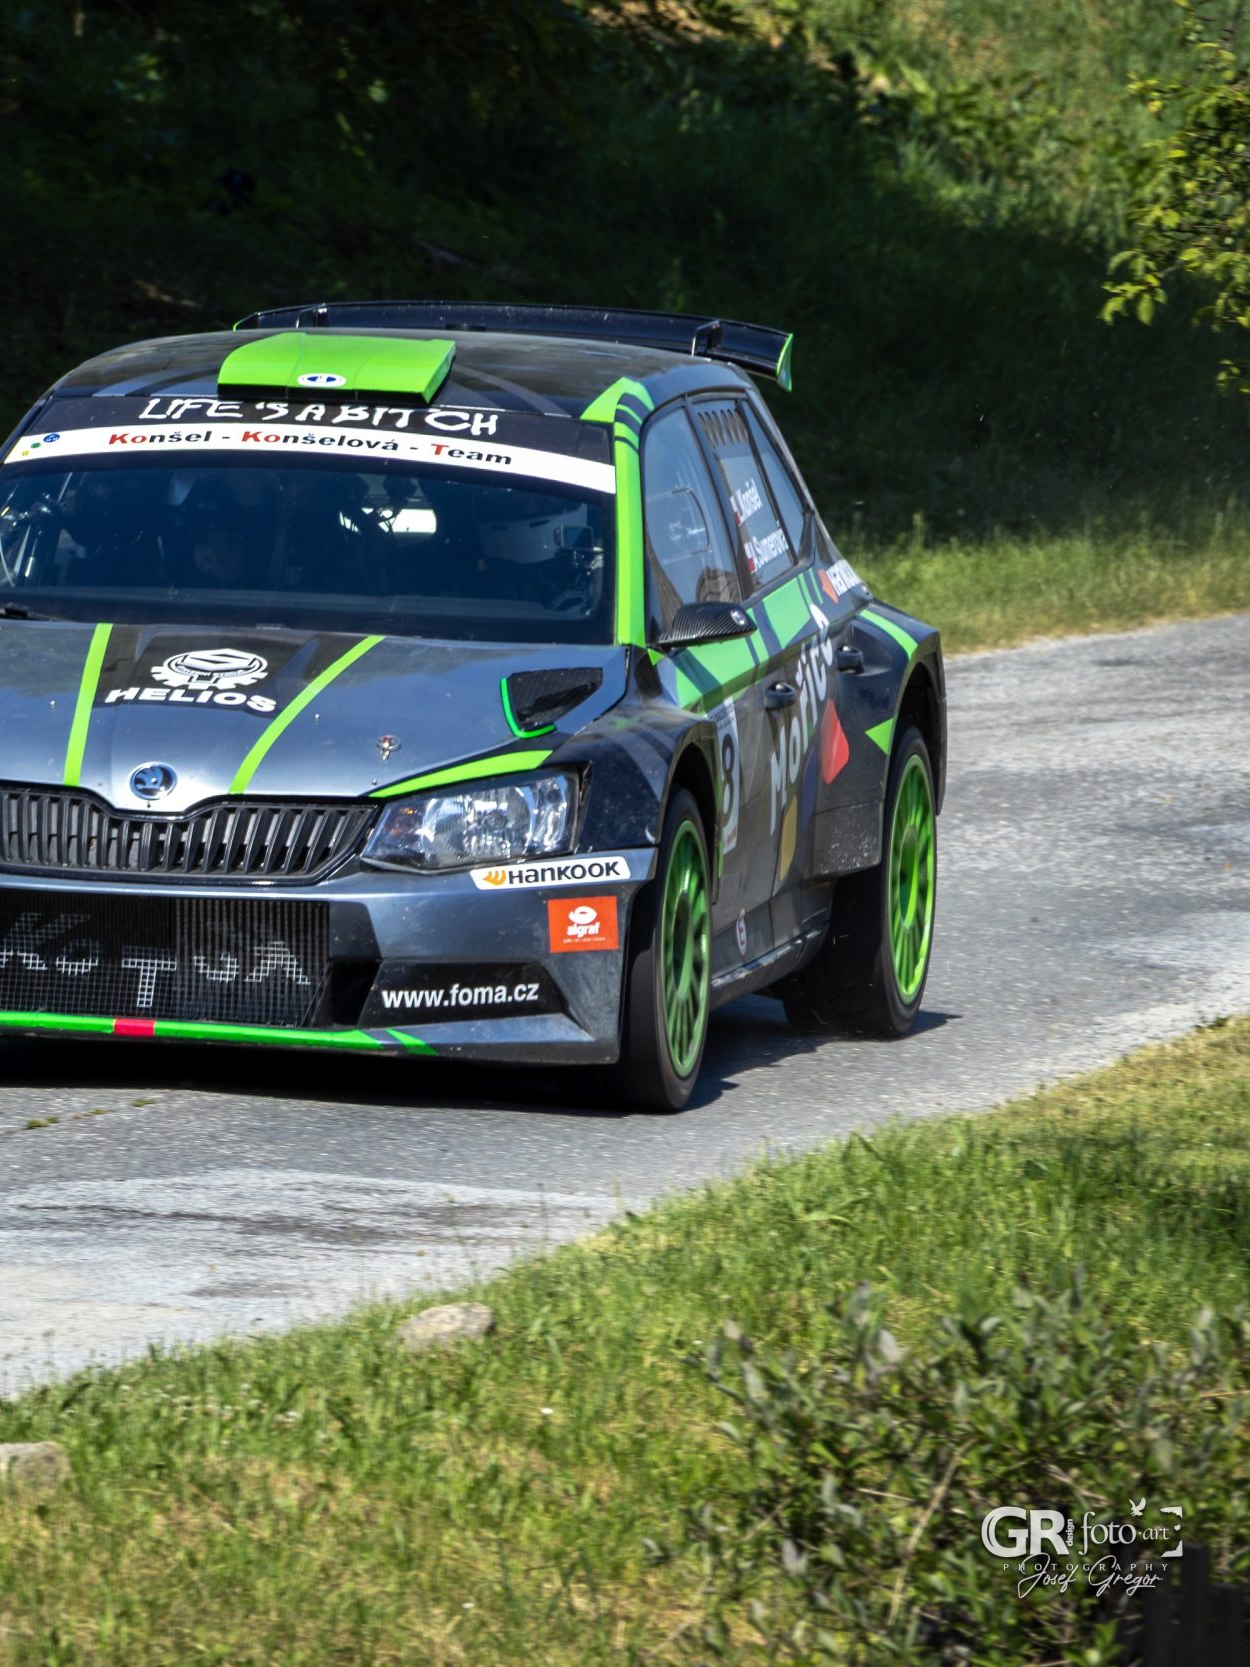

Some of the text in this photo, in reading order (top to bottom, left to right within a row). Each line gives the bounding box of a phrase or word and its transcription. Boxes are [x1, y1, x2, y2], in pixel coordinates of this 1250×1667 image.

[109, 430, 212, 445] Konšel
[241, 430, 399, 451] Konšelová
[430, 443, 512, 466] Team
[104, 686, 277, 713] HELIOS
[382, 982, 540, 1009] www.foma.cz
